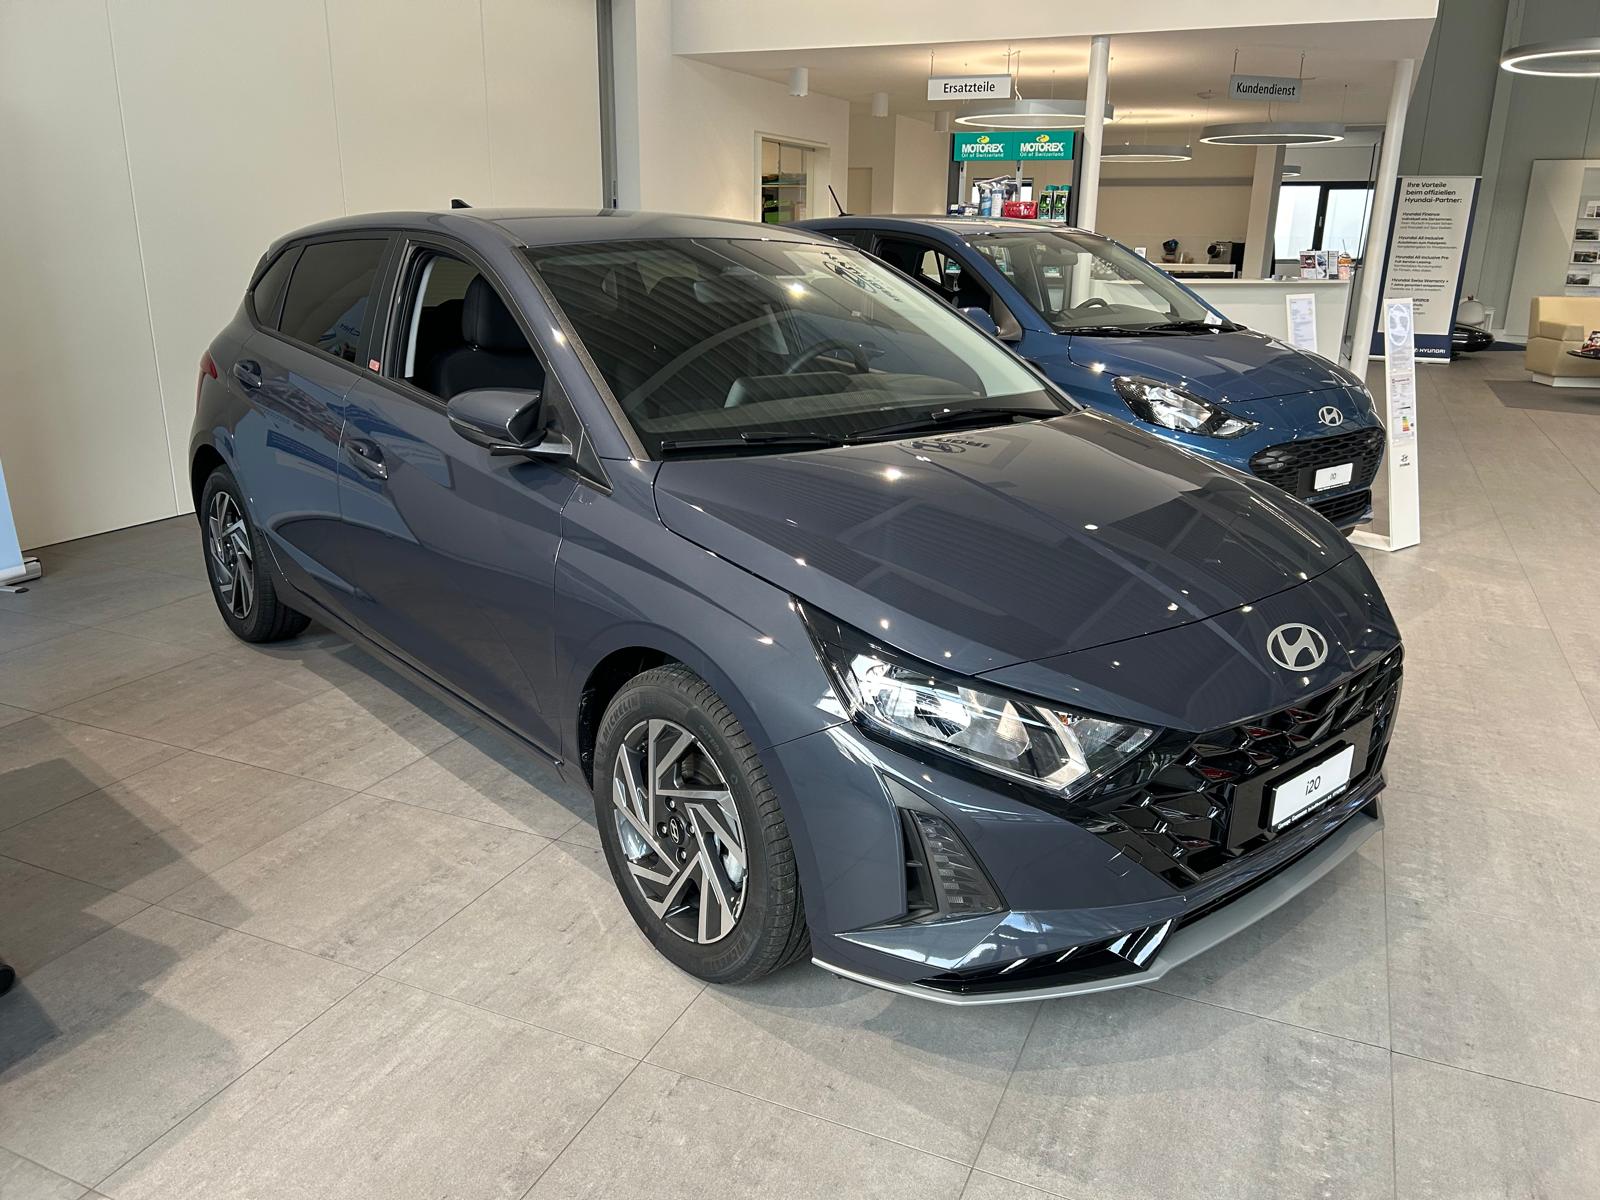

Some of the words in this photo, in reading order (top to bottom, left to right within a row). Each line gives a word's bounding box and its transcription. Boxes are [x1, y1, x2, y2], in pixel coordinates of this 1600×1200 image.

[943, 81, 996, 94] Ersatzteile
[1236, 82, 1296, 95] Kundendienst
[961, 143, 1004, 153] MOTOREX
[1020, 142, 1064, 152] MOTOREX
[602, 694, 641, 742] MICHELIN
[1305, 775, 1321, 796] i20
